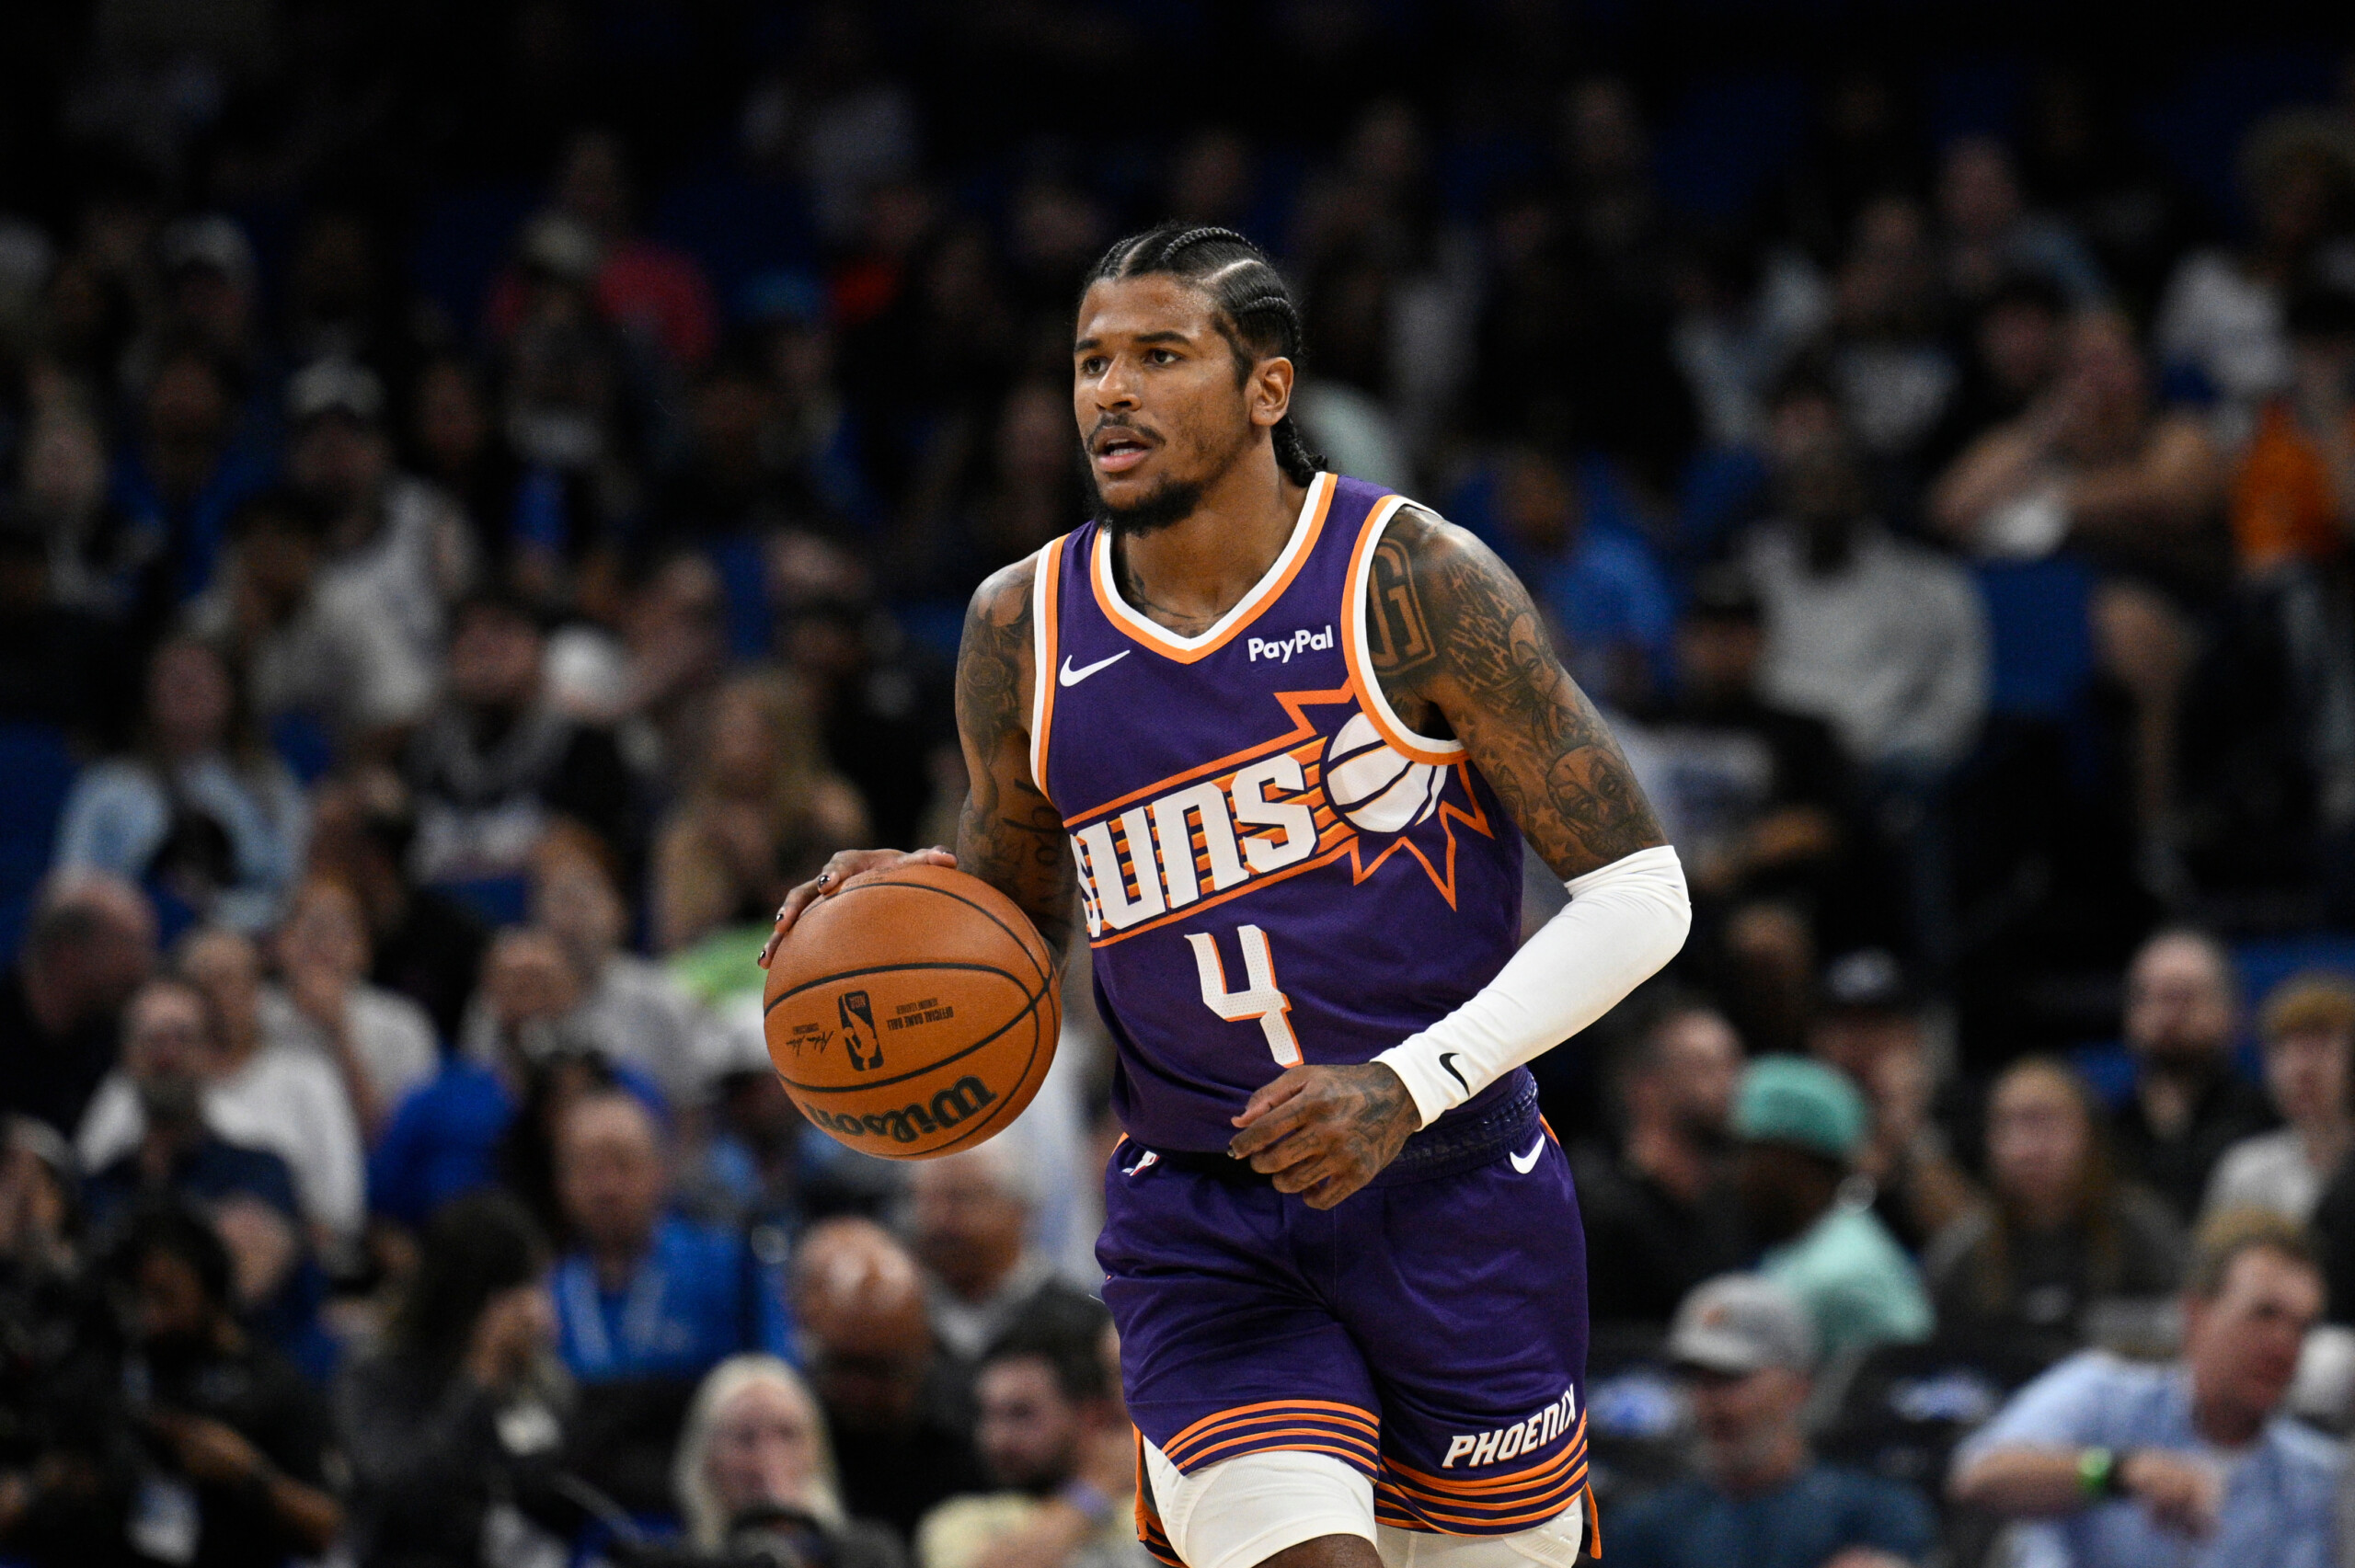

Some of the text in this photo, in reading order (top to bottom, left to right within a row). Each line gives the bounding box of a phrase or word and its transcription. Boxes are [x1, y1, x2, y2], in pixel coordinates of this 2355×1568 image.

[1248, 625, 1335, 663] PayPal
[849, 995, 867, 1009] NBA
[886, 1006, 954, 1031] OFFICIAL GAME BALL
[1184, 924, 1304, 1069] 4
[802, 1075, 998, 1143] Wilson
[1442, 1383, 1576, 1469] PHOENIX
